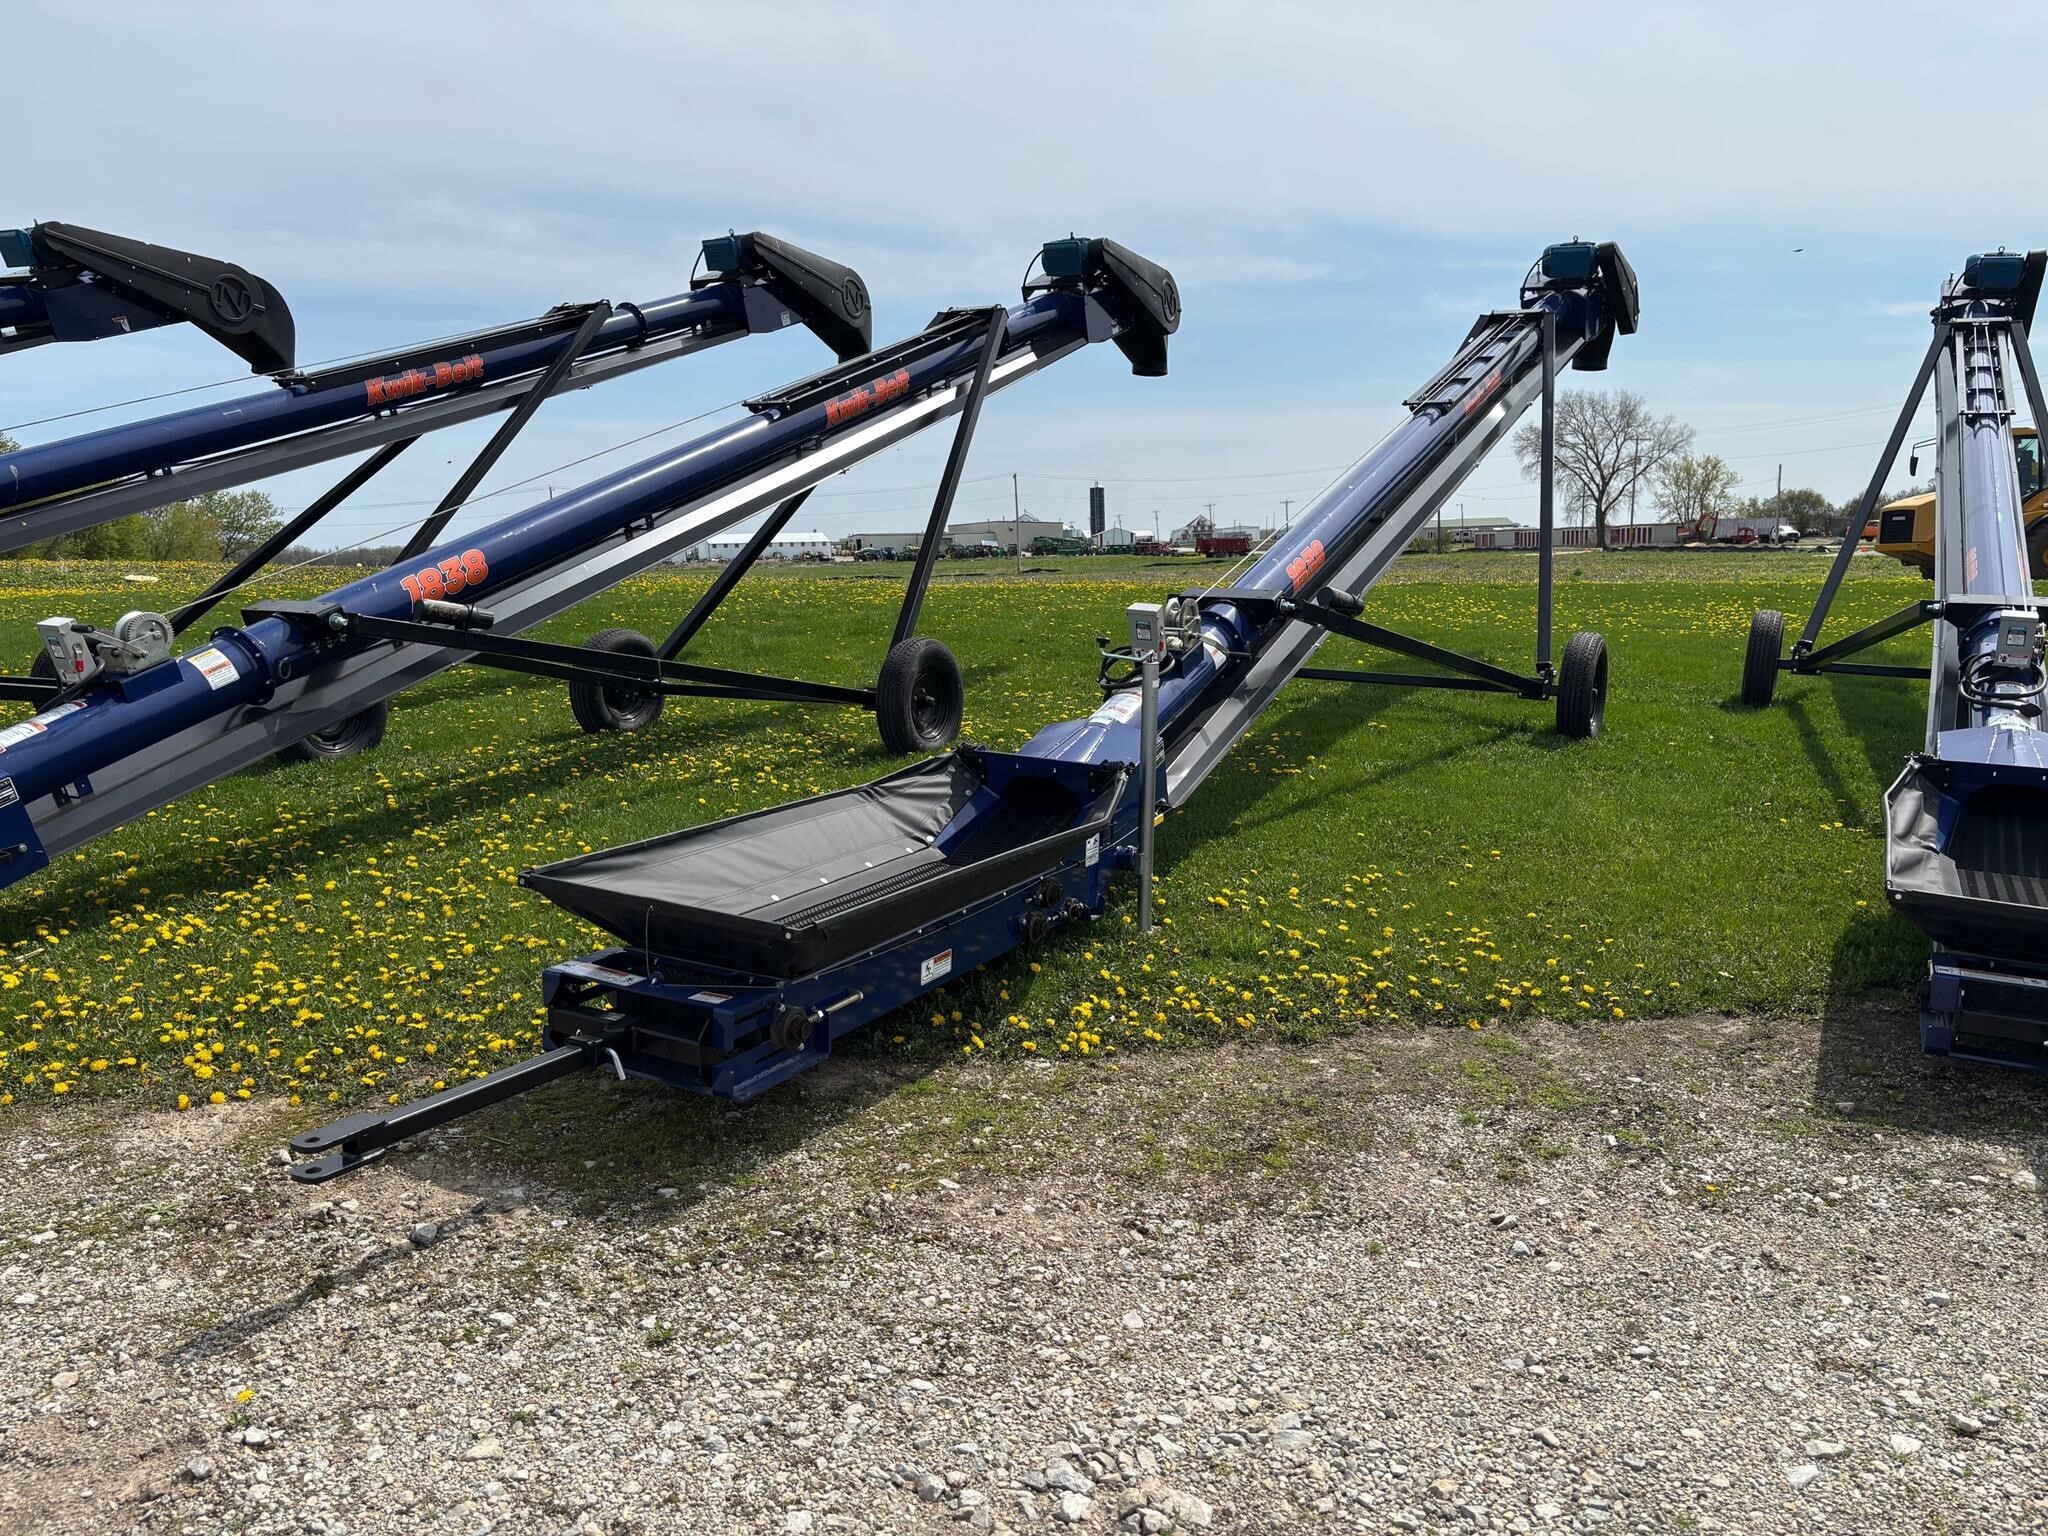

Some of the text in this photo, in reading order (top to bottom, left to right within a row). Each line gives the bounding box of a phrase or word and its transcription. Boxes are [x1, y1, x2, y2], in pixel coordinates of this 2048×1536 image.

[365, 354, 484, 406] Kwik-Belt
[823, 368, 910, 431] Kwik-Belt
[400, 549, 489, 614] 1838
